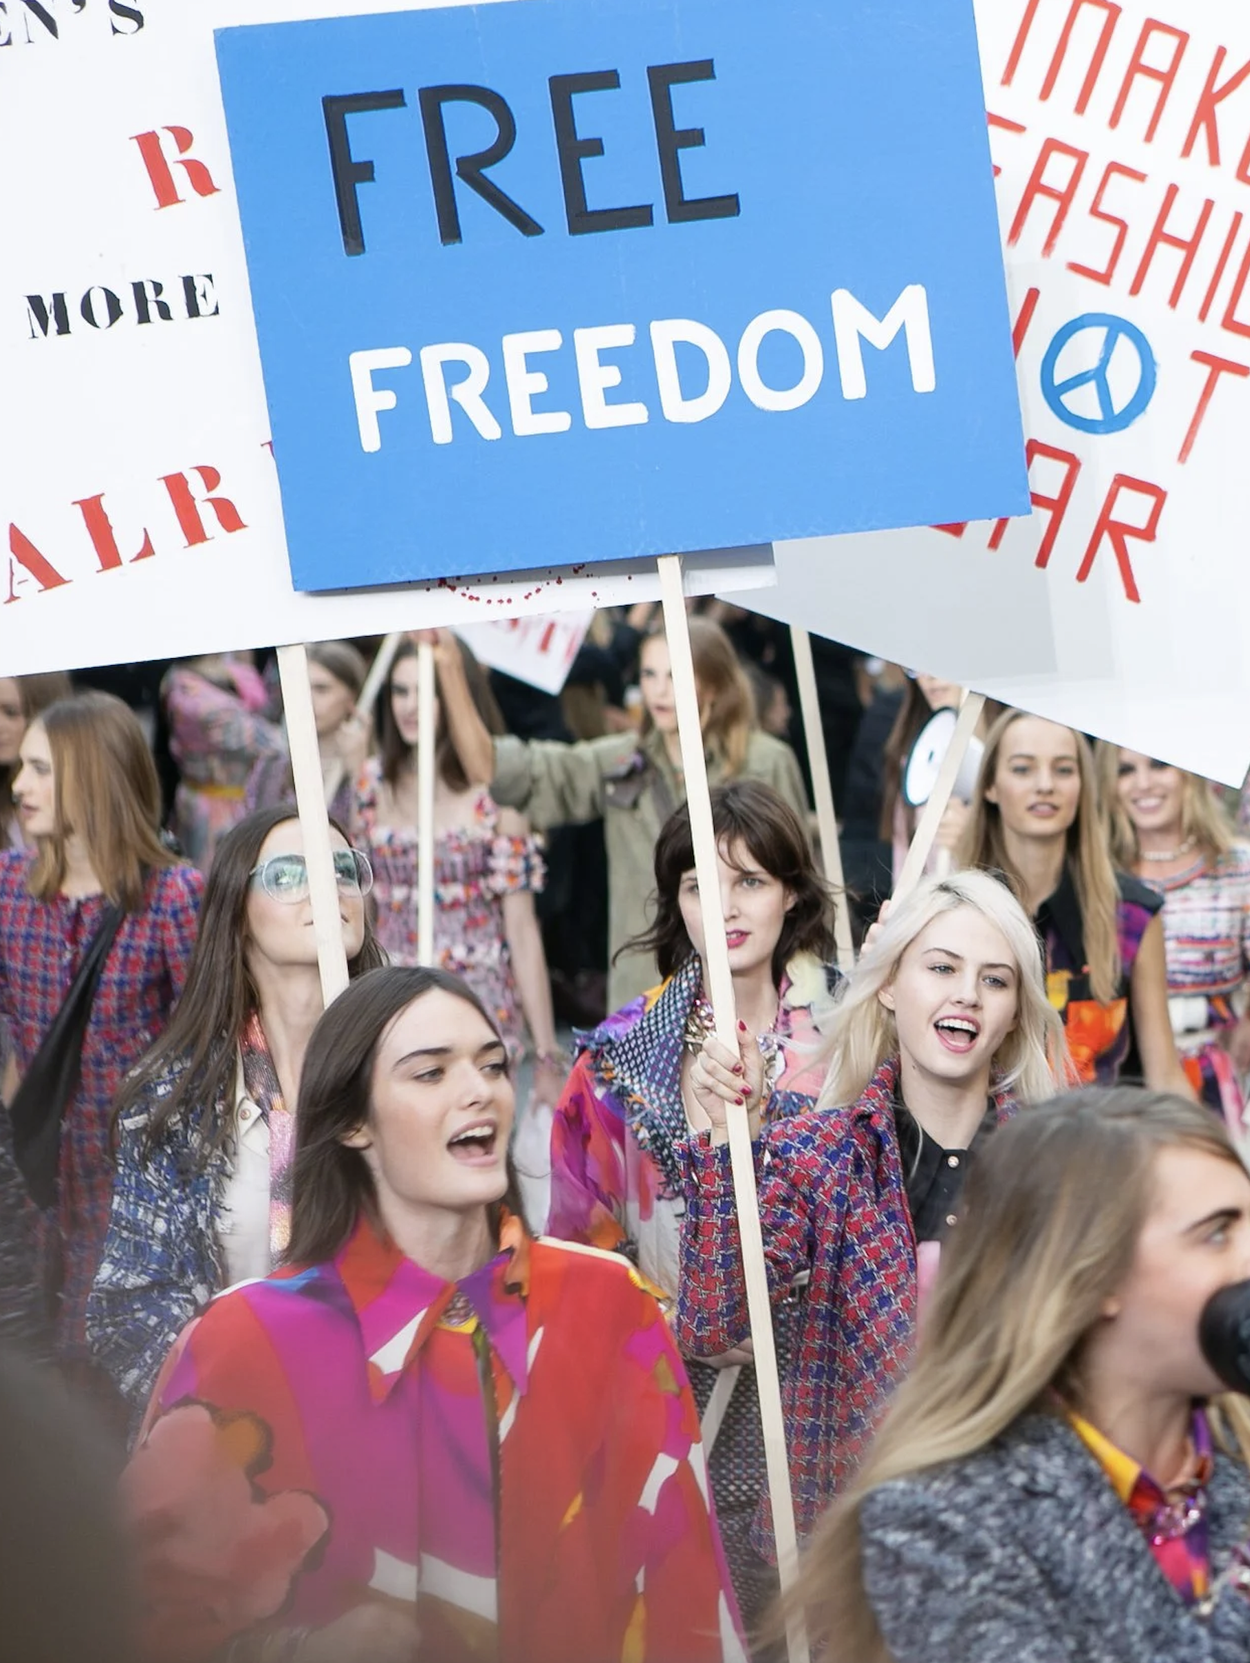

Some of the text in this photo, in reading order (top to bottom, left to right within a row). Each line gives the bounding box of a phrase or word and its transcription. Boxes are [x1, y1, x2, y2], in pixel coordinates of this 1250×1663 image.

[321, 59, 741, 257] FREE
[23, 273, 220, 339] MORE
[348, 283, 937, 453] FREEDOM
[4, 440, 276, 604] ALR
[928, 438, 1168, 604] AR
